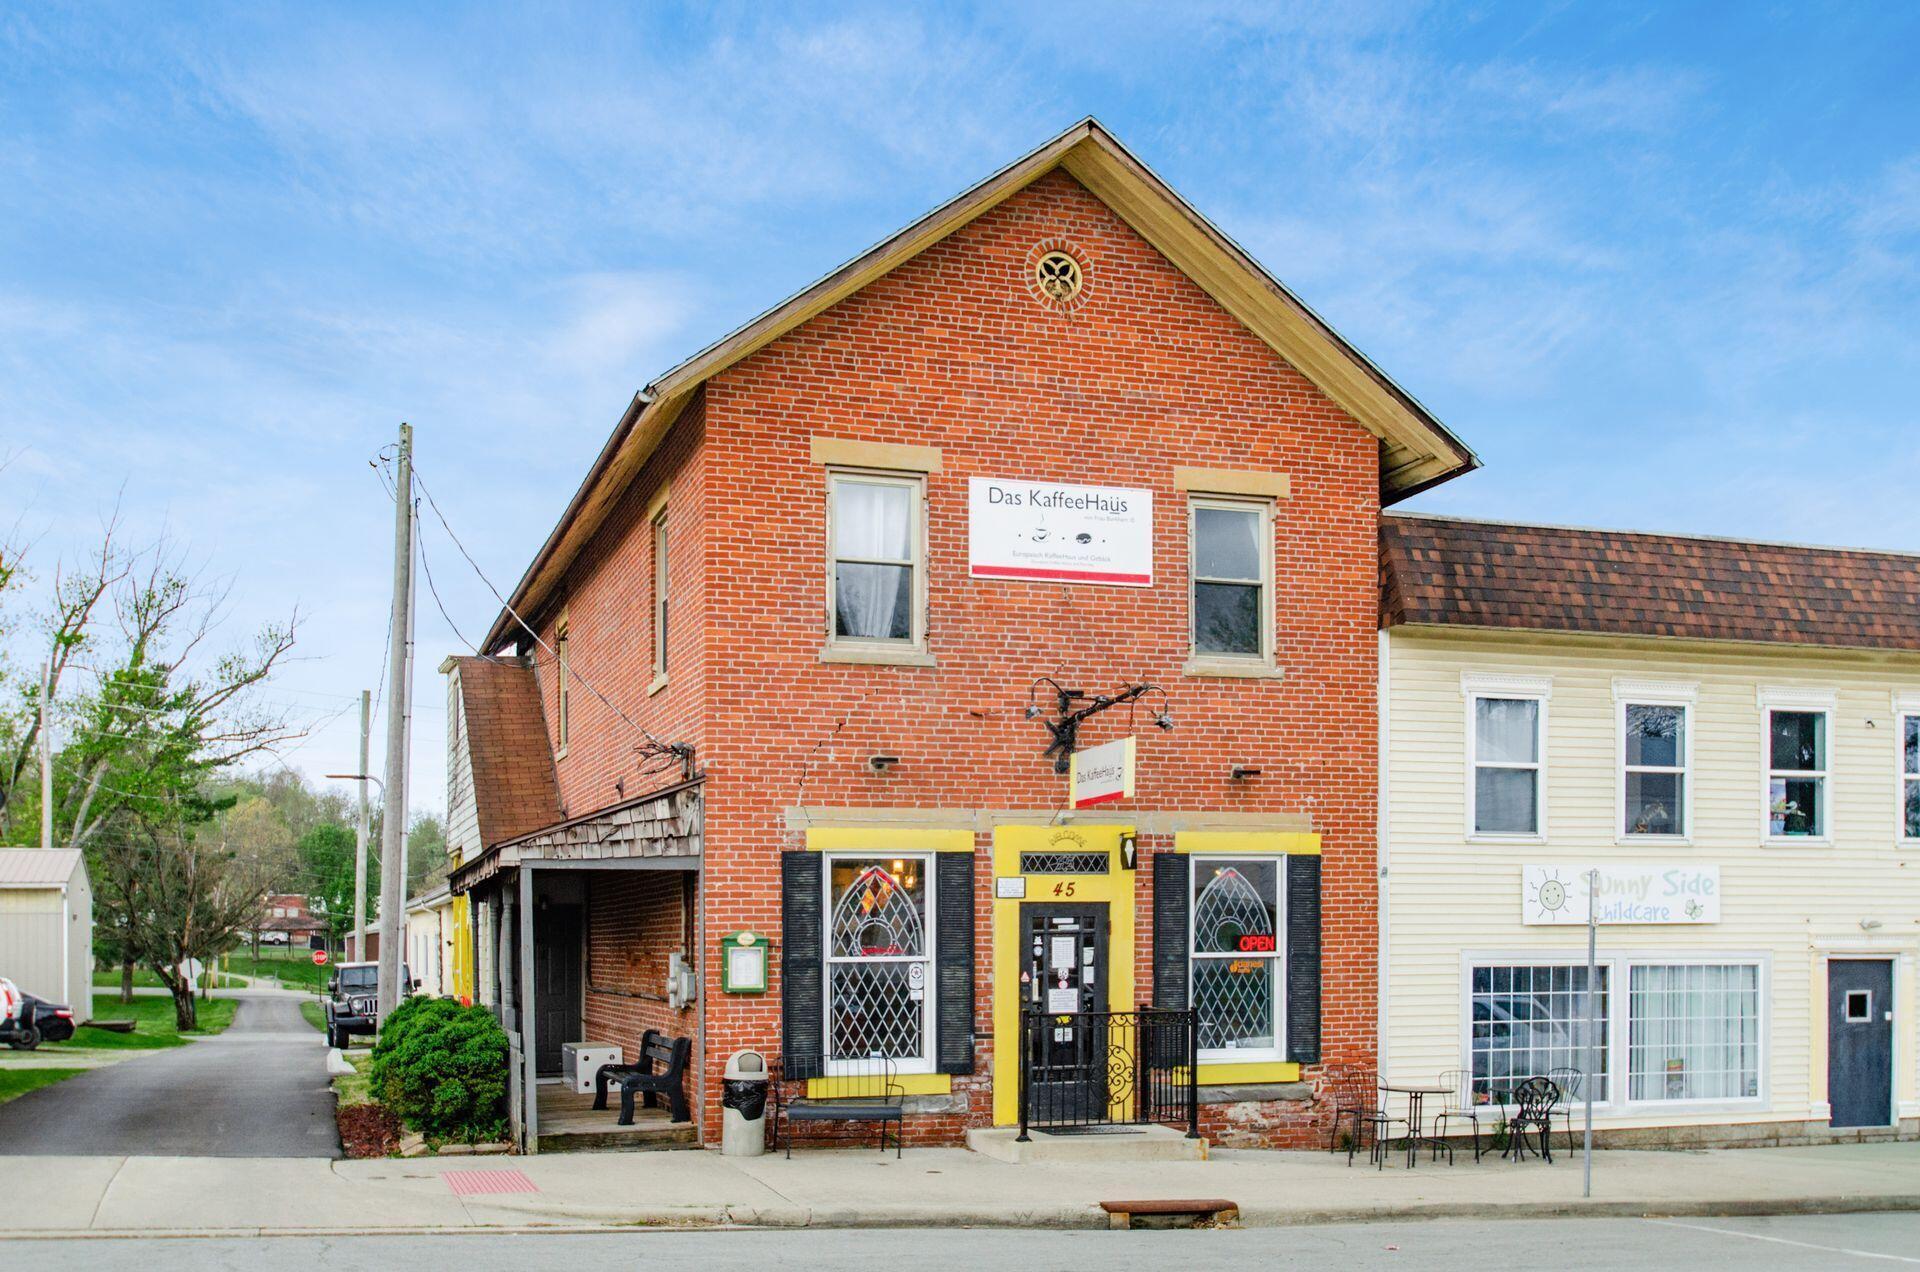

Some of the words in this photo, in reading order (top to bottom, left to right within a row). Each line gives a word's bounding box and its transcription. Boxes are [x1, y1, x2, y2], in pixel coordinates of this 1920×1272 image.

[989, 487, 1022, 505] Das
[1077, 771, 1087, 784] Das
[1053, 882, 1076, 897] 45
[1662, 870, 1714, 896] Side
[1240, 936, 1274, 951] OPEN
